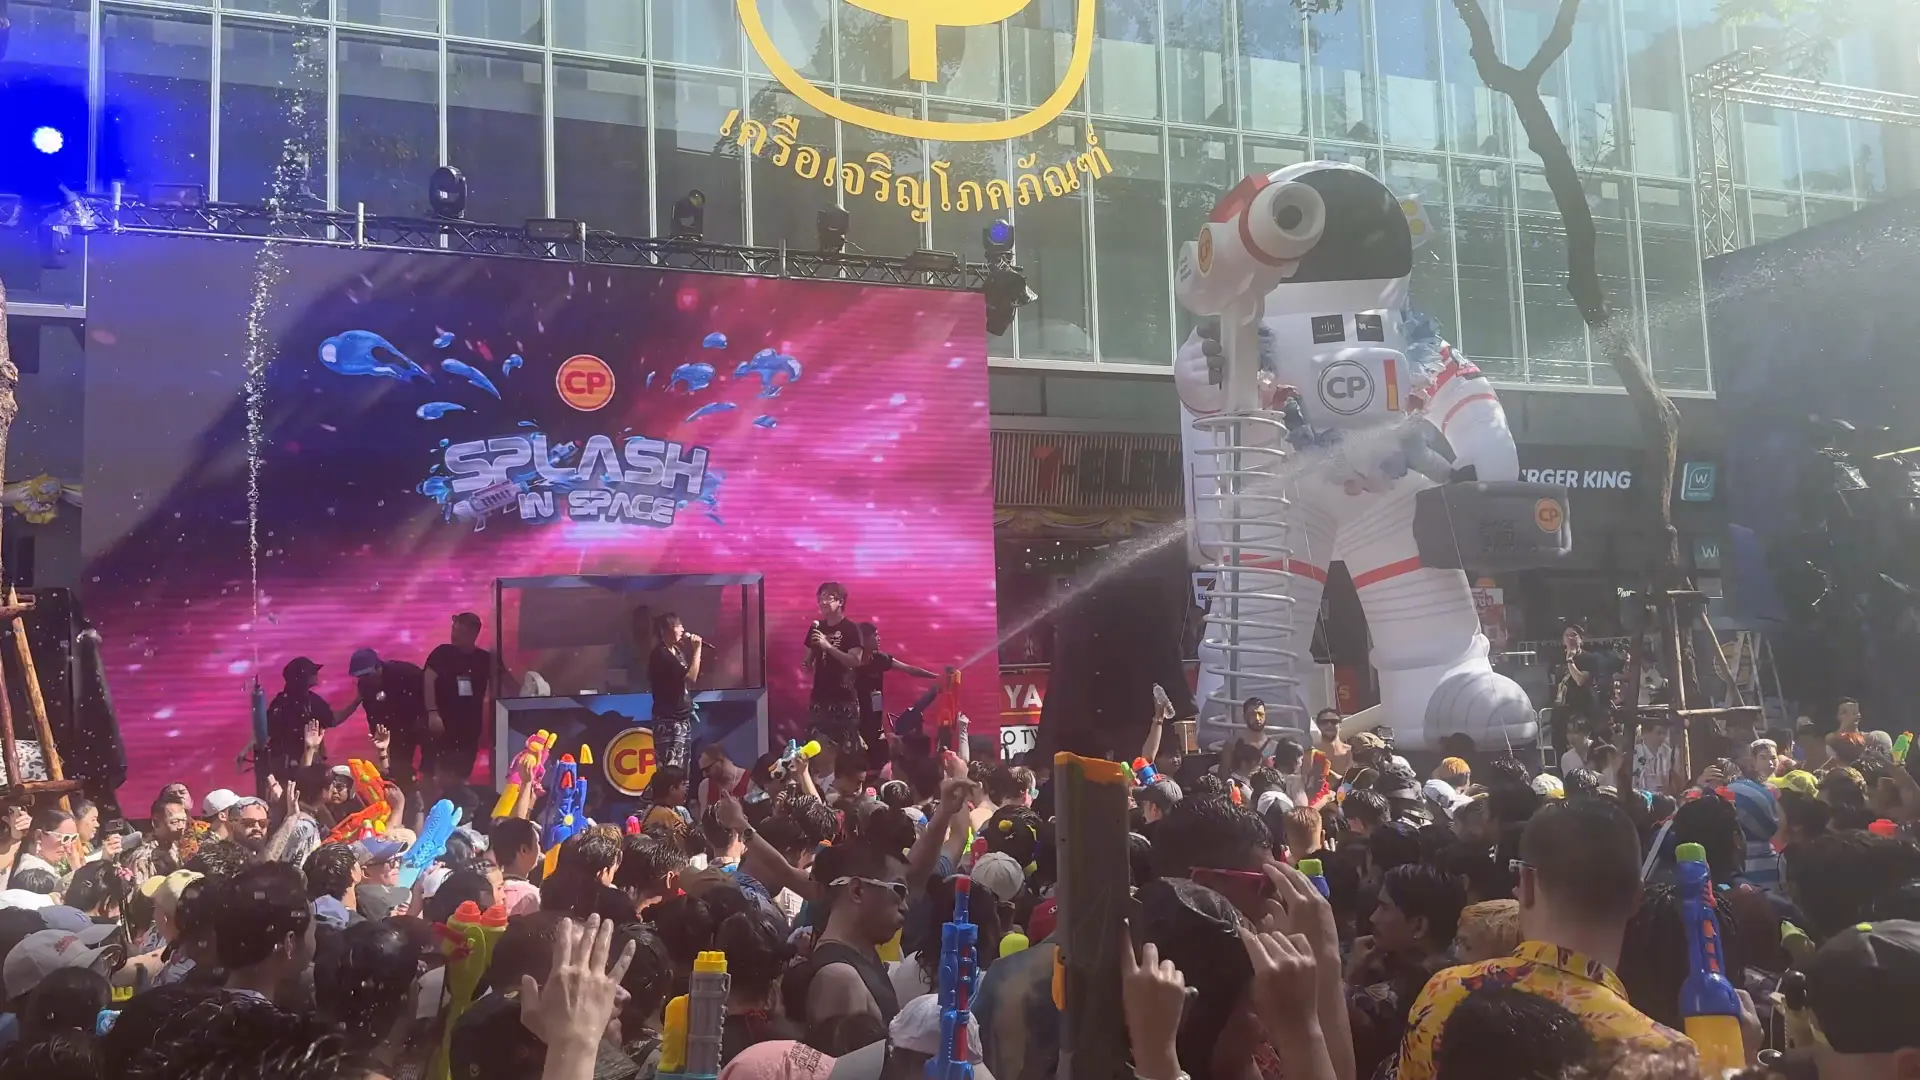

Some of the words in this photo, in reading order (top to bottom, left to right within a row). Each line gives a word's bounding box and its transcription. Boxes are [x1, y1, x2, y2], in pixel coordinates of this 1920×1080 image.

[719, 108, 1113, 223] เครือเจริญโภคภัณฑ์
[563, 370, 607, 394] CP
[1326, 376, 1367, 399] CP
[444, 434, 708, 495] SPLASH
[1521, 468, 1579, 489] RGER
[1582, 470, 1632, 489] KING
[518, 492, 554, 520] IN
[568, 490, 676, 524] SPACE
[613, 748, 657, 775] CP
